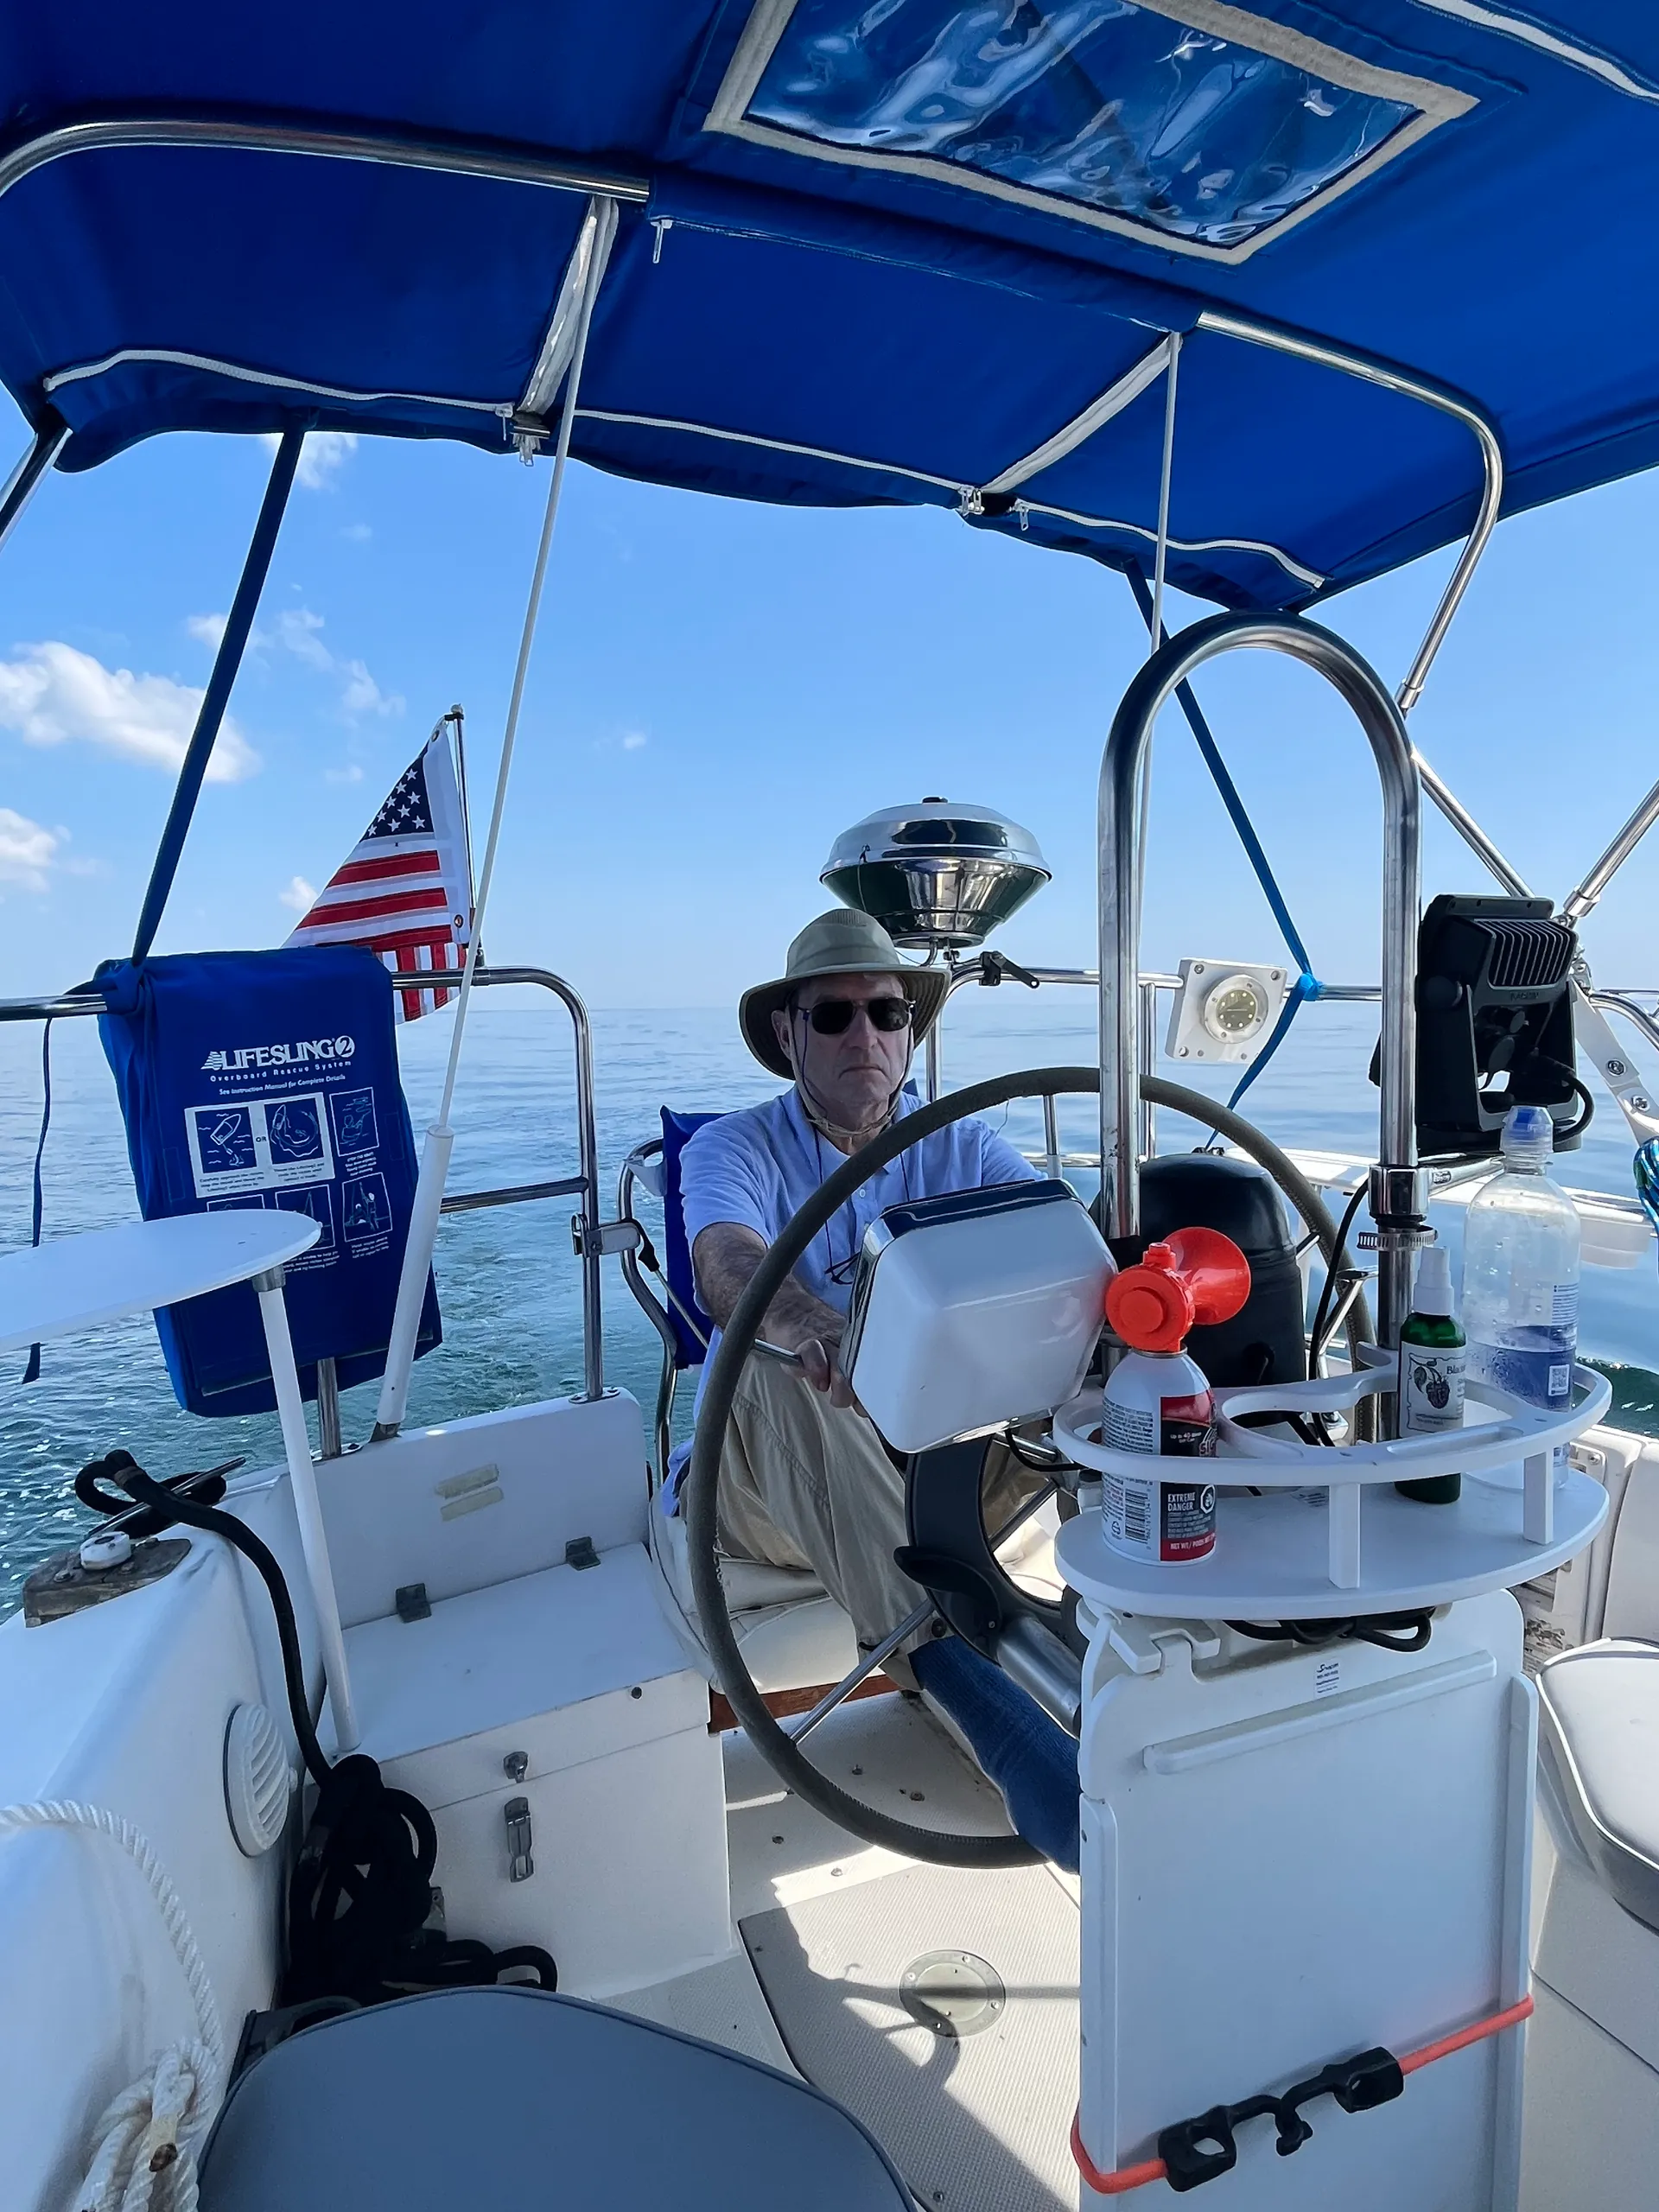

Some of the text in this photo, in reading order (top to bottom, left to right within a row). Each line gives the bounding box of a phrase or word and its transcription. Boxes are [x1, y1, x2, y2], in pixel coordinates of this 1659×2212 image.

[209, 1060, 352, 1082] Overboard Rescue System
[231, 1084, 264, 1095] Instruction
[264, 1082, 288, 1090] Manual
[288, 1080, 296, 1089] for
[297, 1077, 325, 1087] Complete
[326, 1073, 346, 1083] Details
[1167, 1492, 1196, 1503] EXTREME
[1167, 1502, 1194, 1511] DANGER
